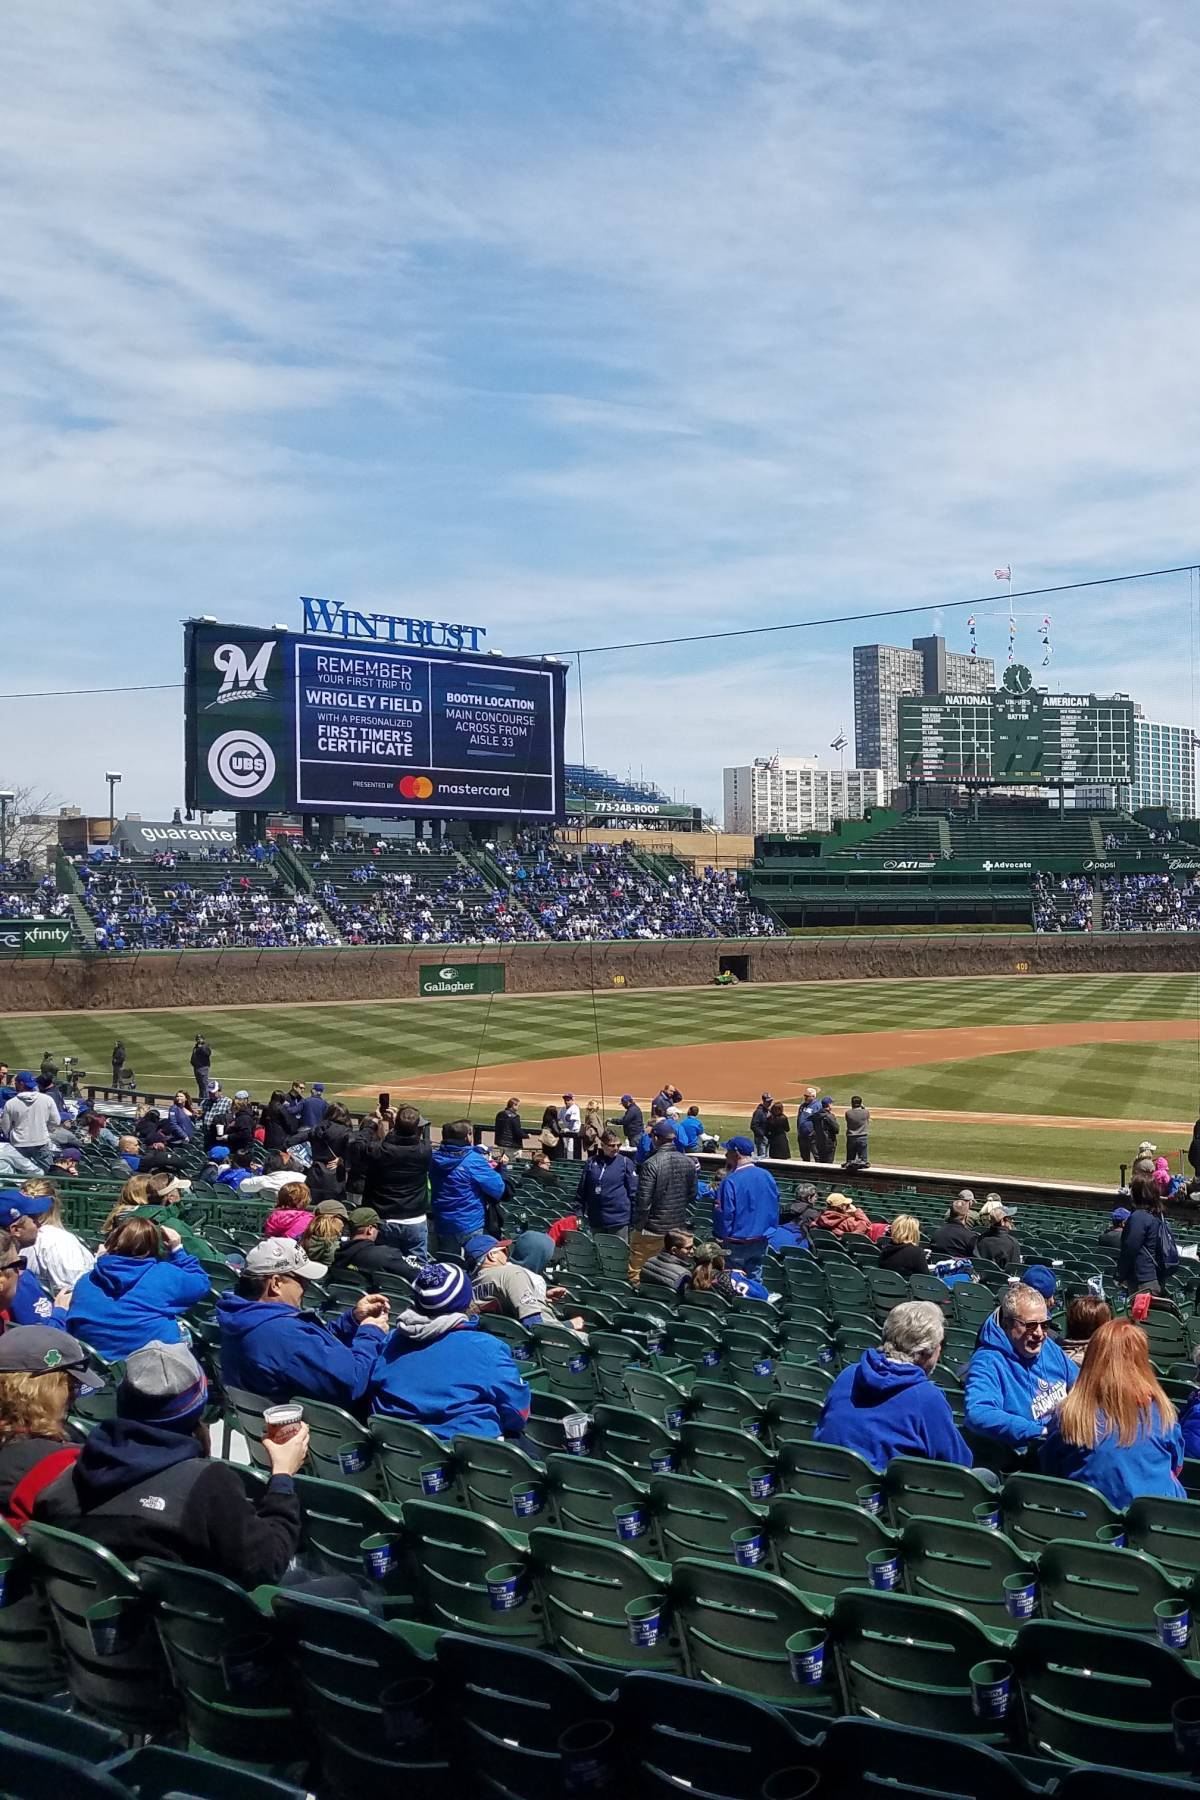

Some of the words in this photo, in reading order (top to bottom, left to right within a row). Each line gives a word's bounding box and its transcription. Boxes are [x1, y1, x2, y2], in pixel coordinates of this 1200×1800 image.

[299, 596, 486, 651] WINTRUST
[317, 656, 412, 680] REMEMBER
[318, 674, 343, 684] YOUR
[347, 677, 374, 688] FIRST
[376, 679, 397, 689] TRIP
[400, 681, 412, 691] TO
[306, 690, 376, 709] WRIGLEY
[380, 697, 422, 713] FIELD
[446, 693, 482, 704] BOOTH
[485, 697, 535, 710] LOCATION
[945, 695, 993, 705] NATIONAL
[1042, 697, 1090, 706] AMERICAN
[317, 713, 340, 722] WITH
[342, 715, 348, 723] A
[350, 715, 413, 728] PERSONALIZED
[446, 709, 472, 720] MAIN
[475, 712, 536, 726] CONCOURSE
[318, 725, 357, 739] FIRST
[360, 728, 412, 743] TIMER'S
[455, 722, 496, 734] ACROSS
[499, 725, 527, 736] FROM
[317, 738, 413, 757] CERTIFICATE
[470, 735, 499, 746] AISLE
[502, 737, 514, 747] 33
[353, 781, 385, 789] PRESENTED
[438, 783, 511, 797] mastercard
[594, 802, 660, 815] 773-248-ROOF
[896, 861, 918, 869] ATI
[994, 861, 1032, 869] Advocate
[1094, 861, 1116, 870] pepsi
[24, 927, 69, 943] xfinity
[424, 981, 474, 993] Gallagher
